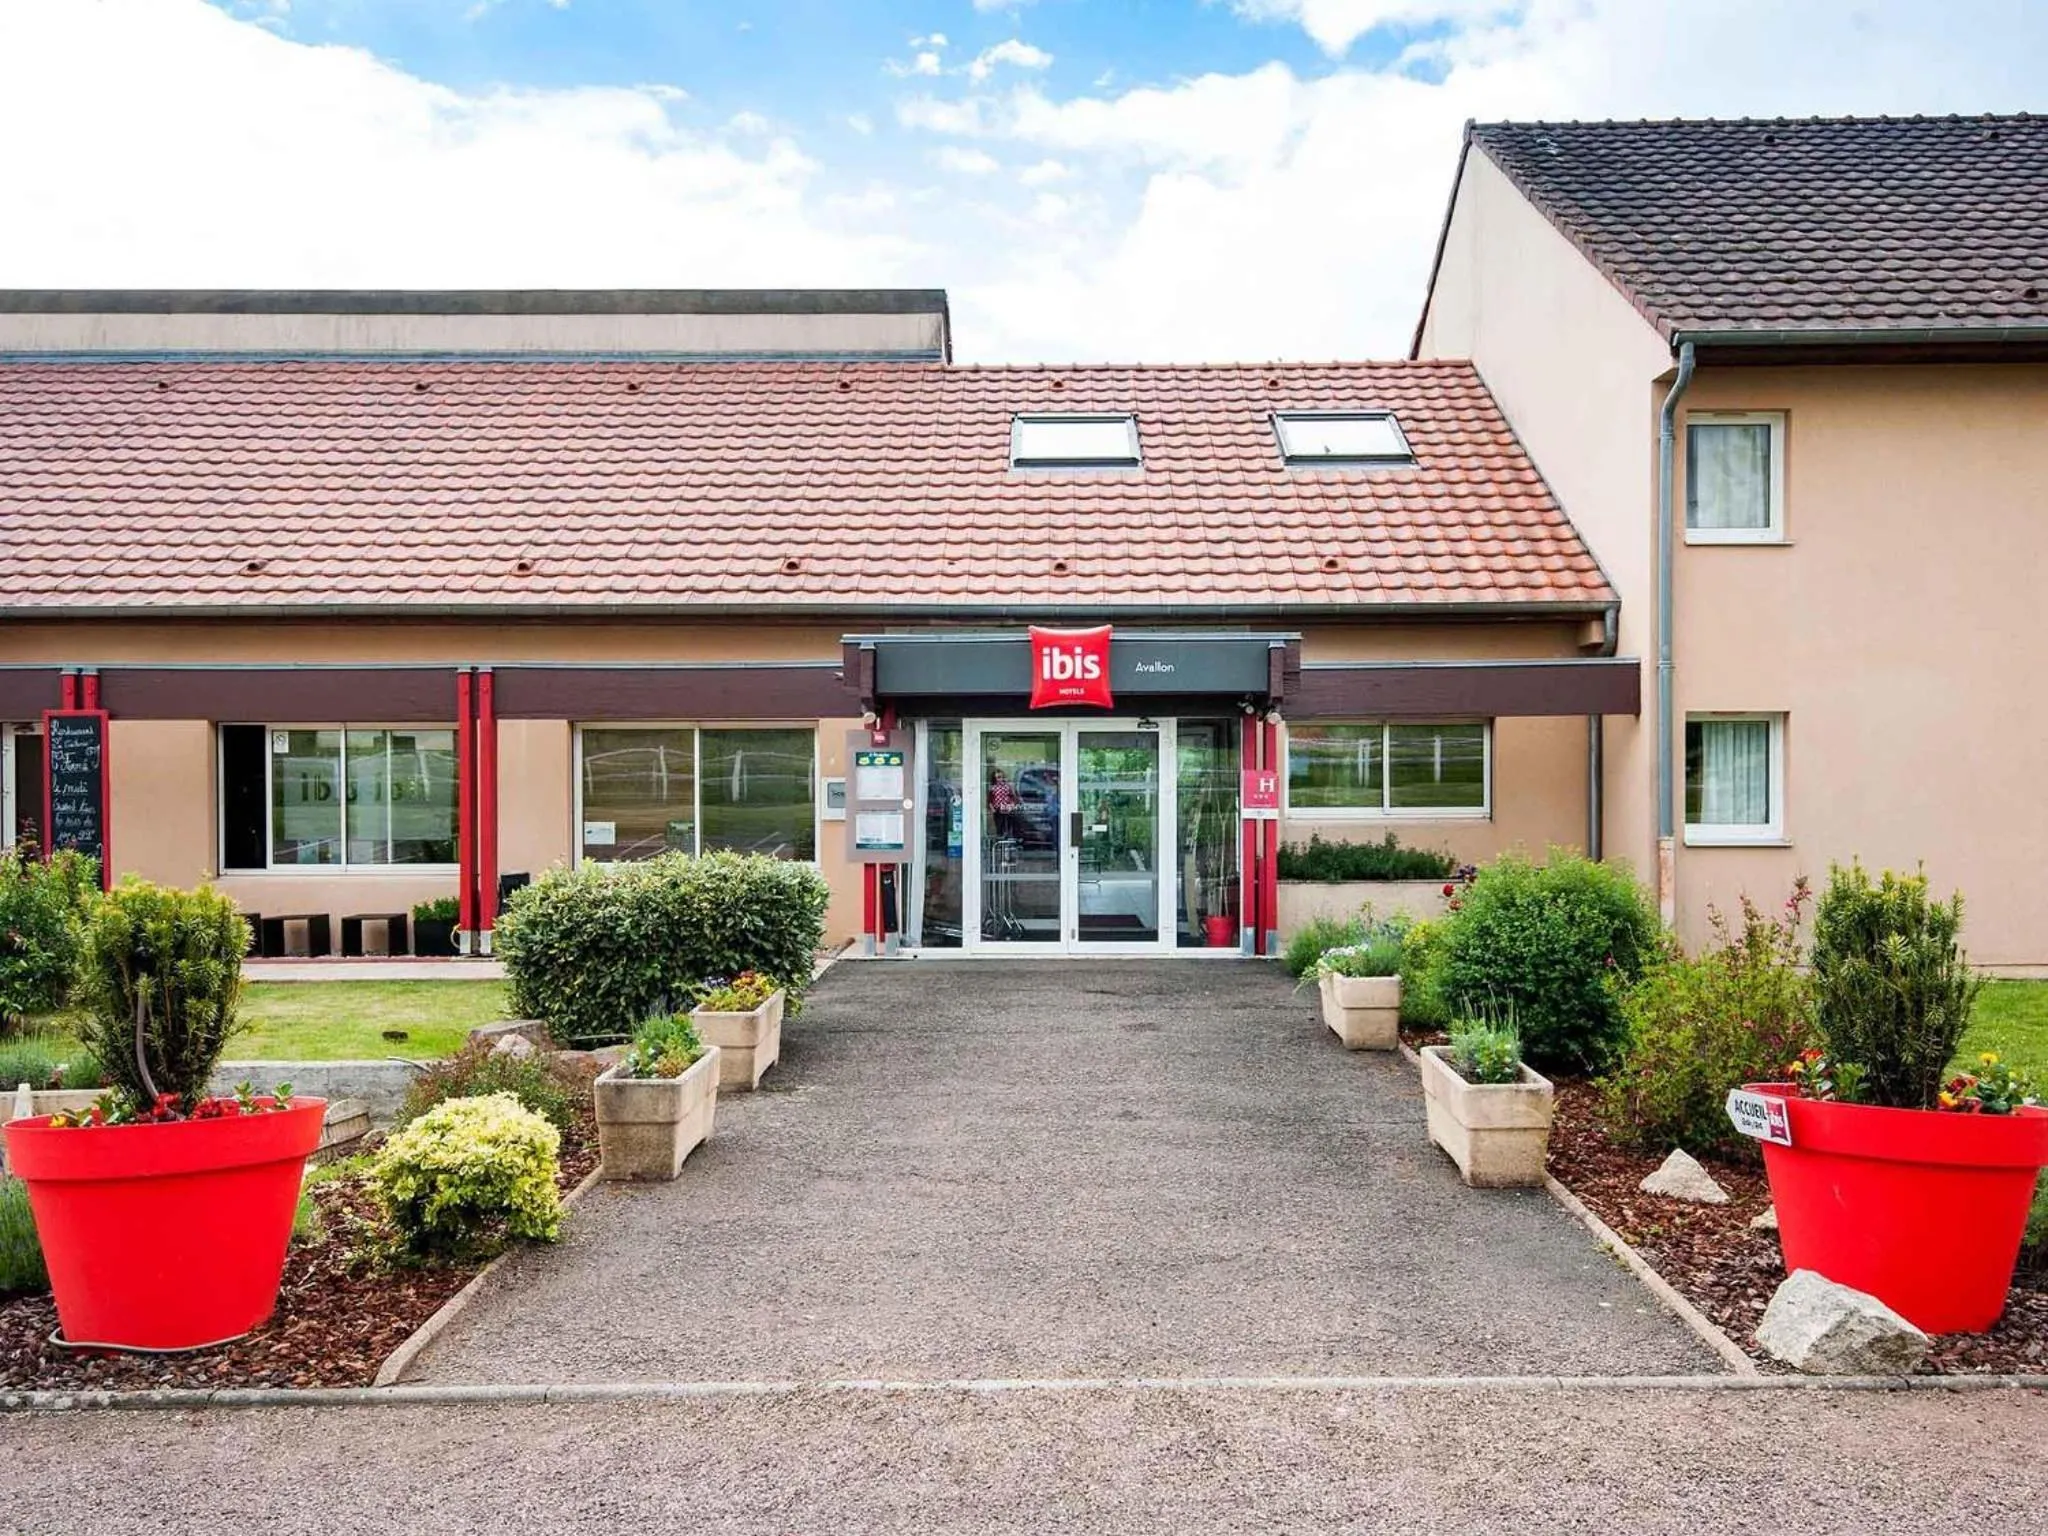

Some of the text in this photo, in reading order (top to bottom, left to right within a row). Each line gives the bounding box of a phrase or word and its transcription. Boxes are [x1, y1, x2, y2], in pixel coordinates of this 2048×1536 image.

[1042, 646, 1101, 680] ibis
[1135, 661, 1175, 673] Avallon
[1059, 687, 1085, 695] HOTELS
[1259, 777, 1276, 793] H
[1734, 1098, 1767, 1120] ACCUEIL
[1767, 1111, 1784, 1128] ibis
